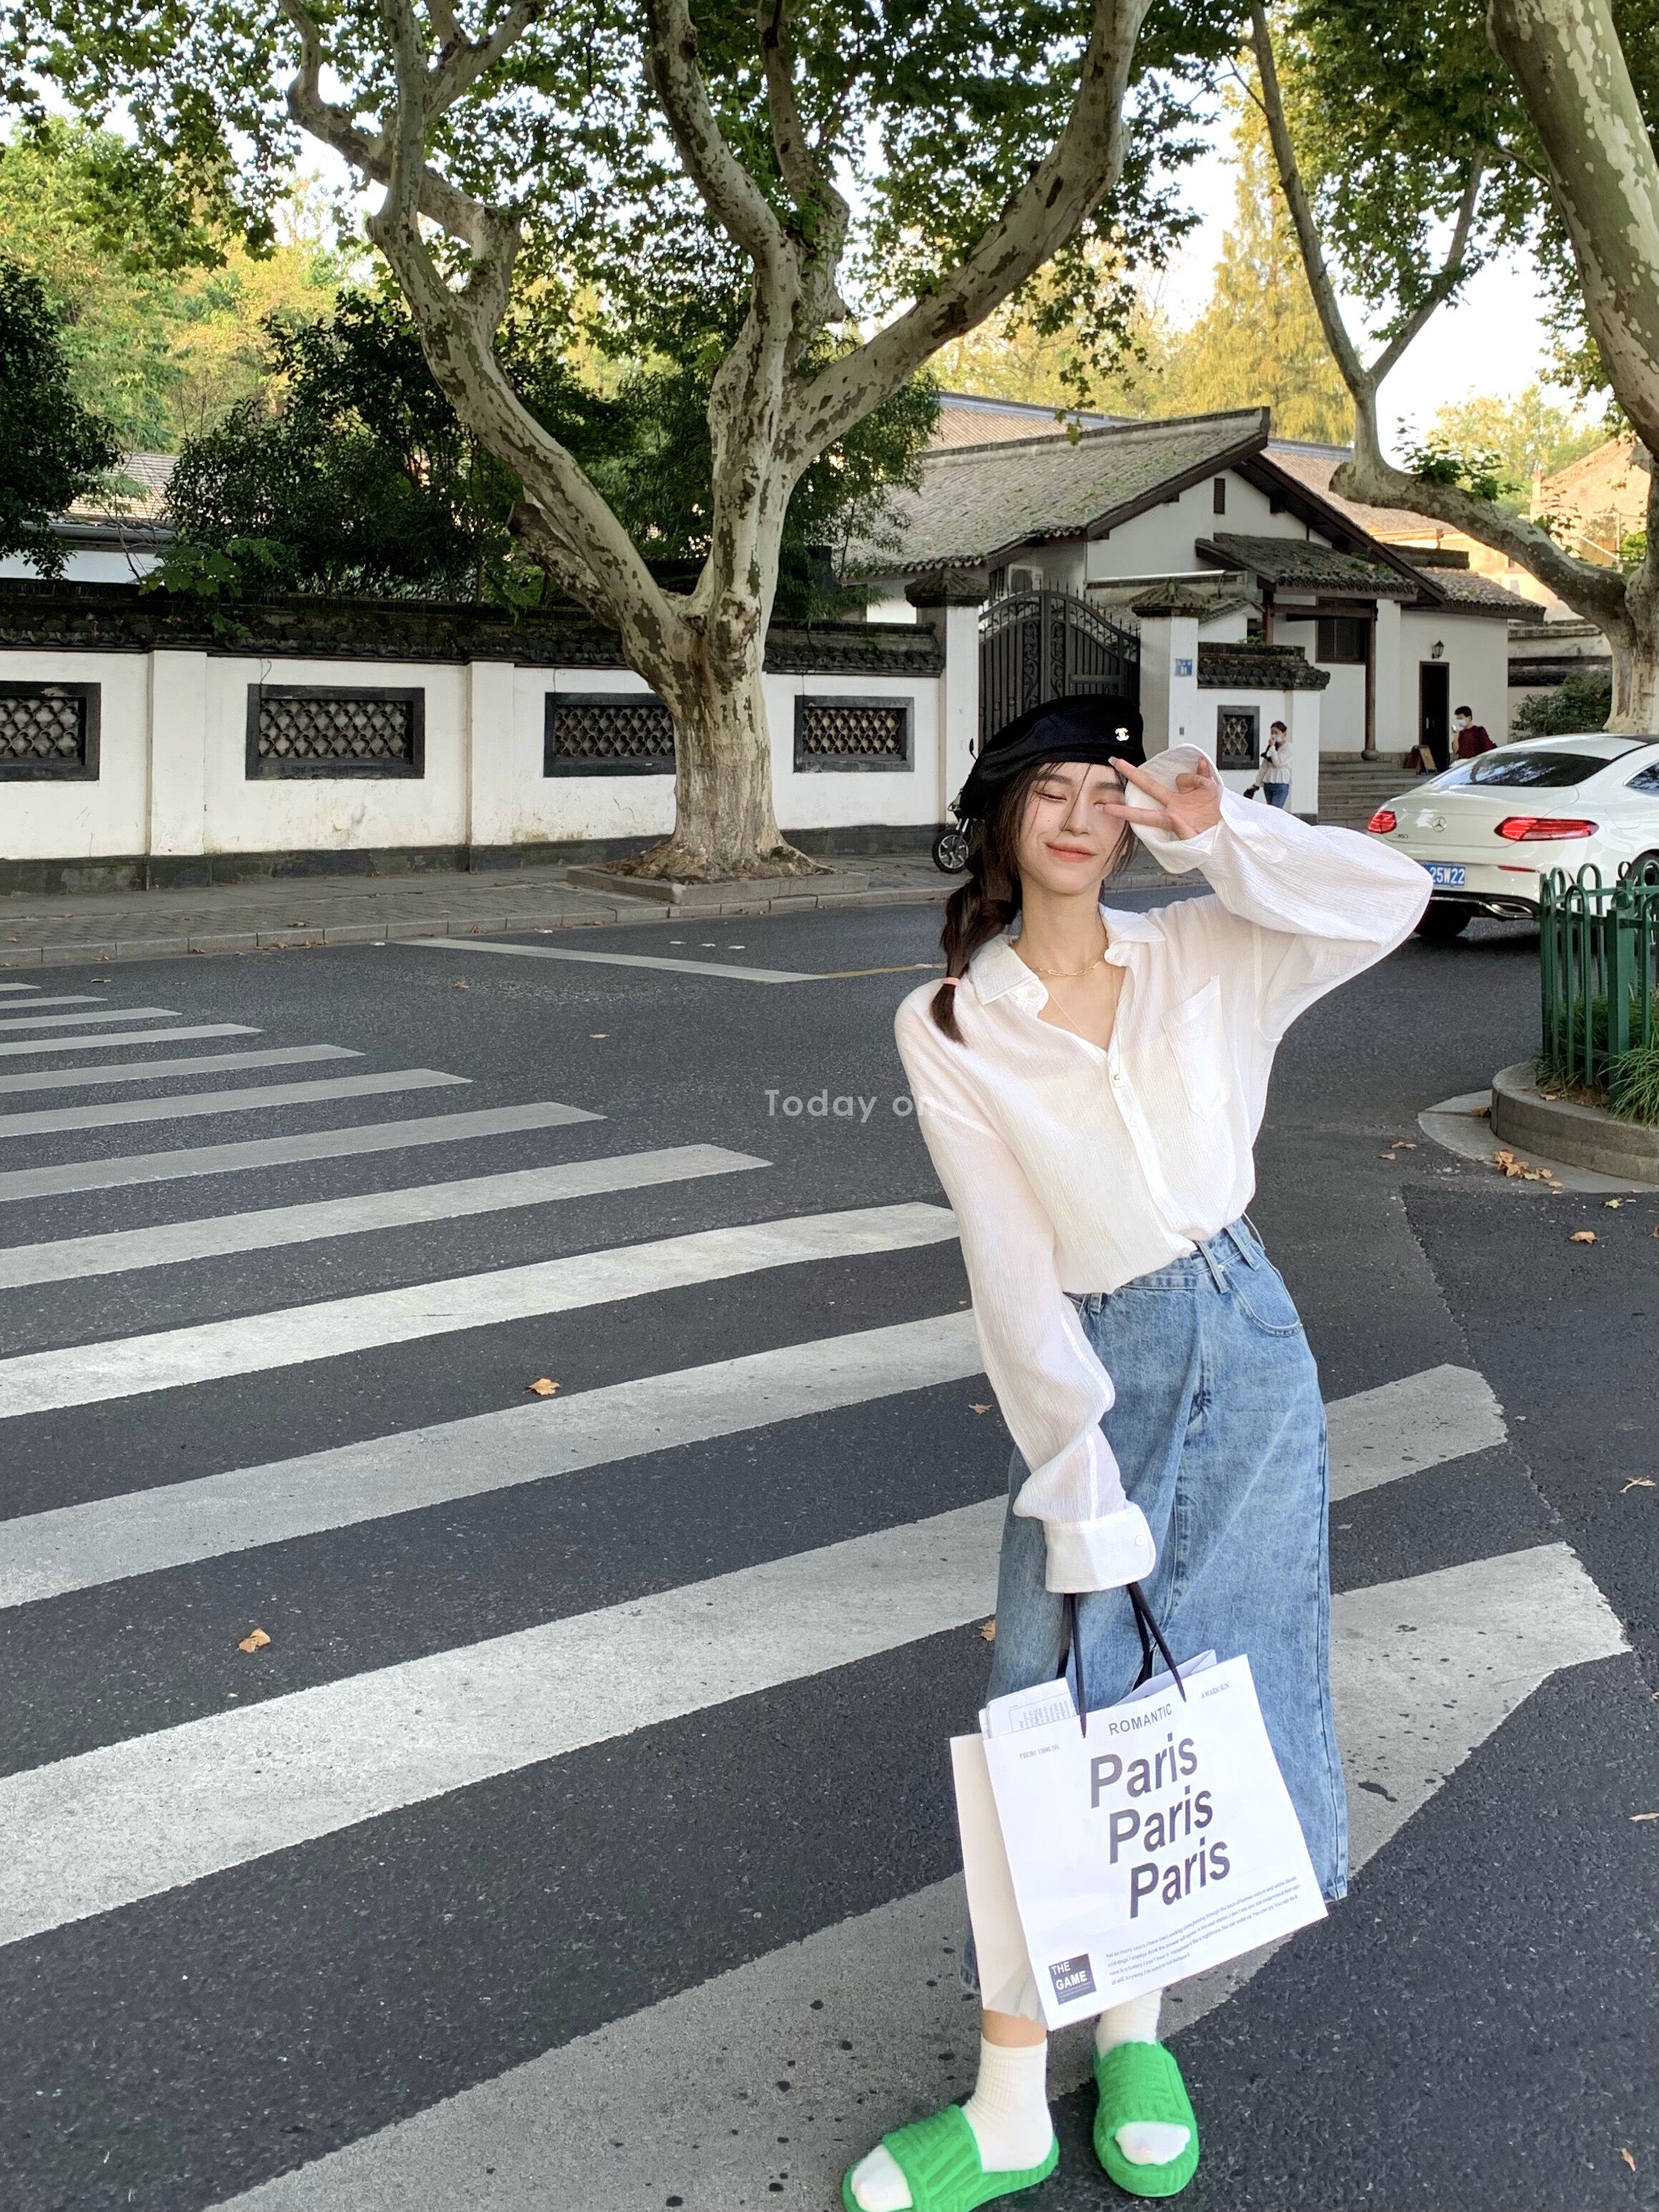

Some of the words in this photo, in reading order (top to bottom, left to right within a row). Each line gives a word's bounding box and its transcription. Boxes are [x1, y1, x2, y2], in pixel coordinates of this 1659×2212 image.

[1108, 1703, 1173, 1736] ROMANTIC
[1090, 1732, 1199, 1809] Paris
[1109, 1785, 1214, 1865] Paris
[1130, 1836, 1232, 1920] Paris
[1051, 1961, 1071, 1976] THE
[1055, 1970, 1088, 1991] GAME
